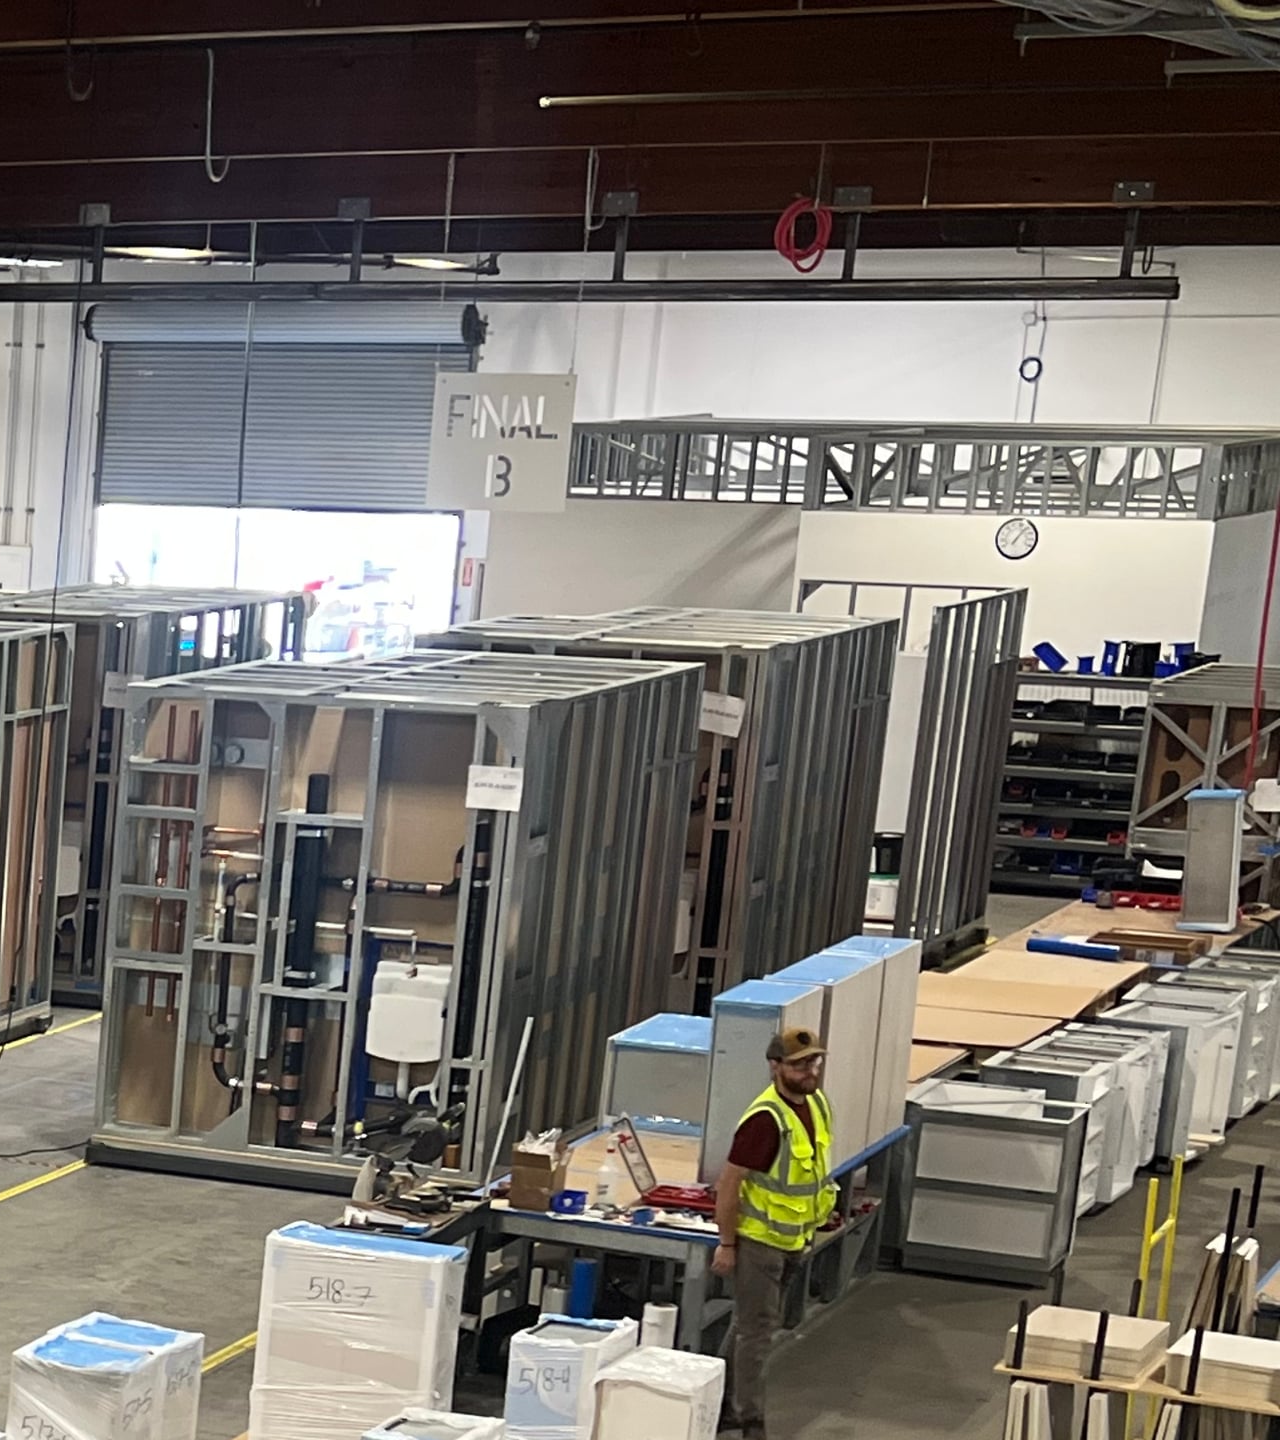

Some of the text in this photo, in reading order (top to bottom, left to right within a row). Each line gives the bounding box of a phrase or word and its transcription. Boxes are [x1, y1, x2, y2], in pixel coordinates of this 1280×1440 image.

[446, 394, 558, 440] FINAL
[484, 454, 513, 499] B
[306, 1275, 378, 1308] 518-7
[517, 1365, 572, 1396] 518-4
